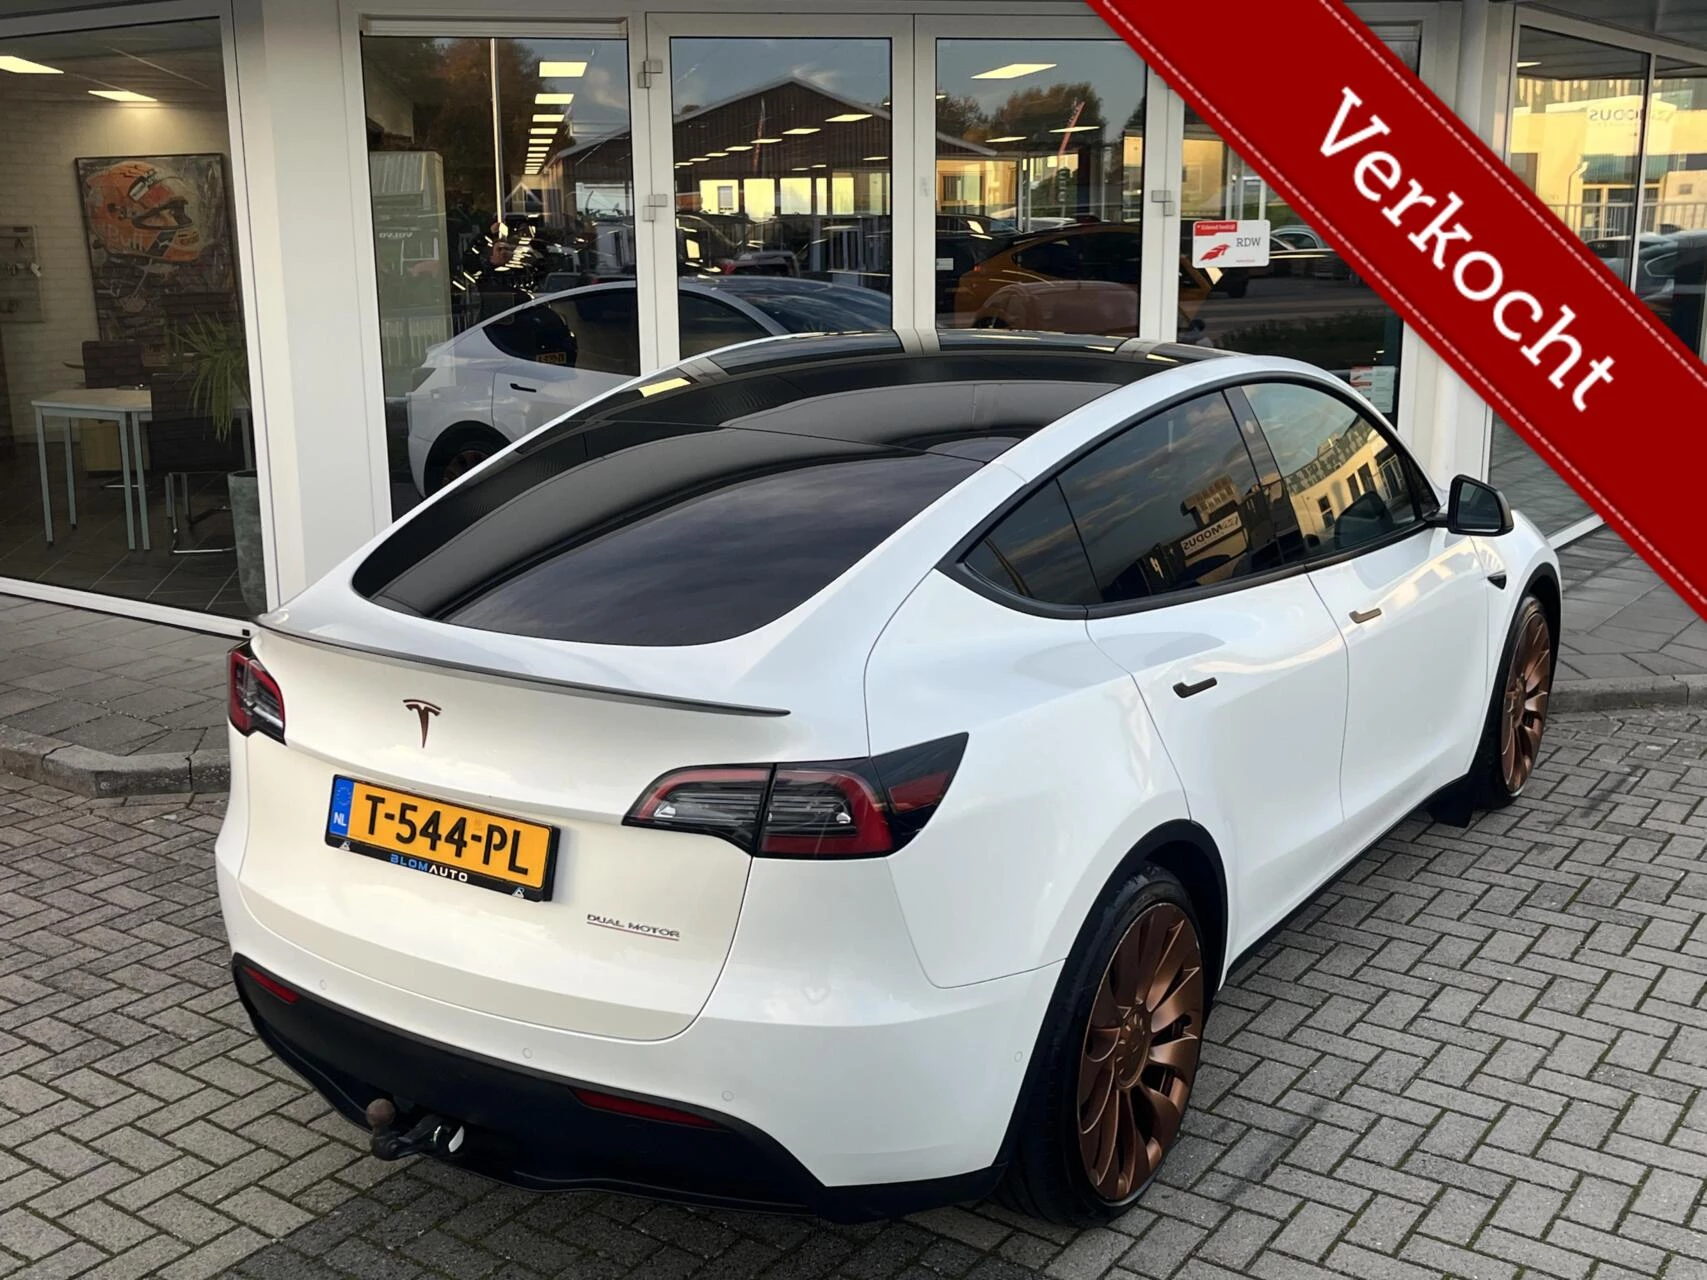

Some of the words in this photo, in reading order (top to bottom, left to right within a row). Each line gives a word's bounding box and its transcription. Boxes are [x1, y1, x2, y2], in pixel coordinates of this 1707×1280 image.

[1236, 237, 1261, 248] RDW
[333, 812, 347, 827] NL
[365, 794, 529, 875] T-544-PL
[390, 853, 468, 882] BLOMAUTO
[587, 913, 624, 928] DUAL
[628, 922, 680, 938] MOTOR
